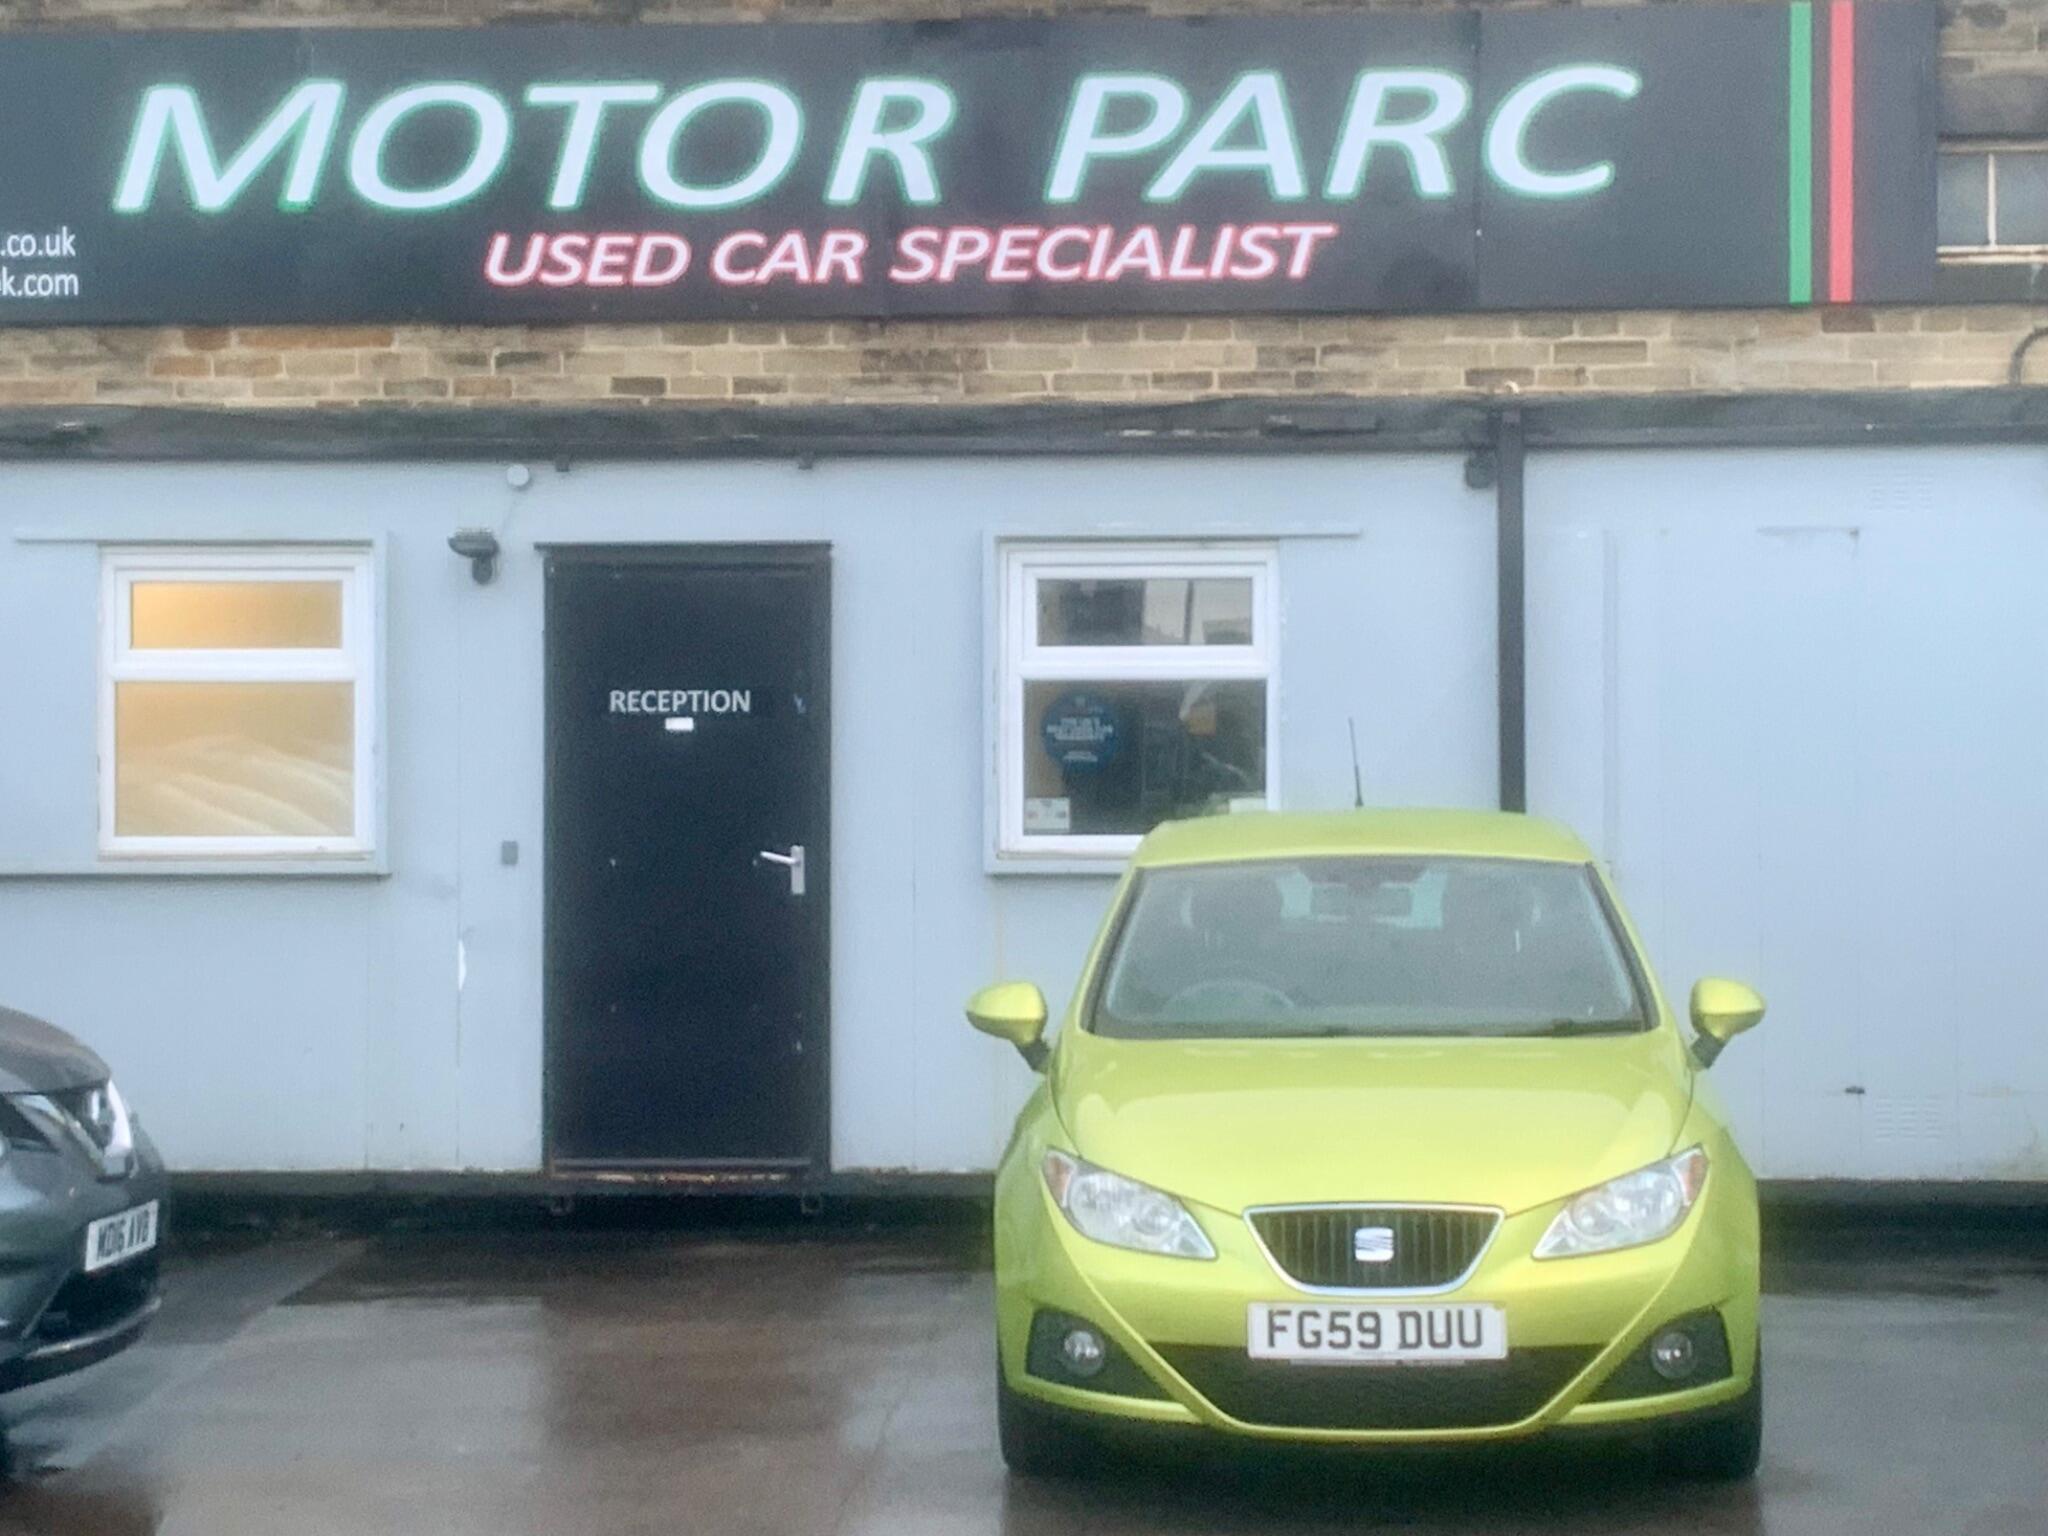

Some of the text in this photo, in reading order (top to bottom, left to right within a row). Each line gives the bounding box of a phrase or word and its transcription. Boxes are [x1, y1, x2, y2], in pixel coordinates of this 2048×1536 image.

[111, 62, 1642, 213] MOTOR PARC
[0, 226, 76, 257] .co.uk
[485, 223, 1338, 287] USED CAR SPECIALIST
[0, 266, 79, 297] k.com
[609, 689, 751, 713] RECEPTION
[1267, 1309, 1483, 1350] FG59 DUU
